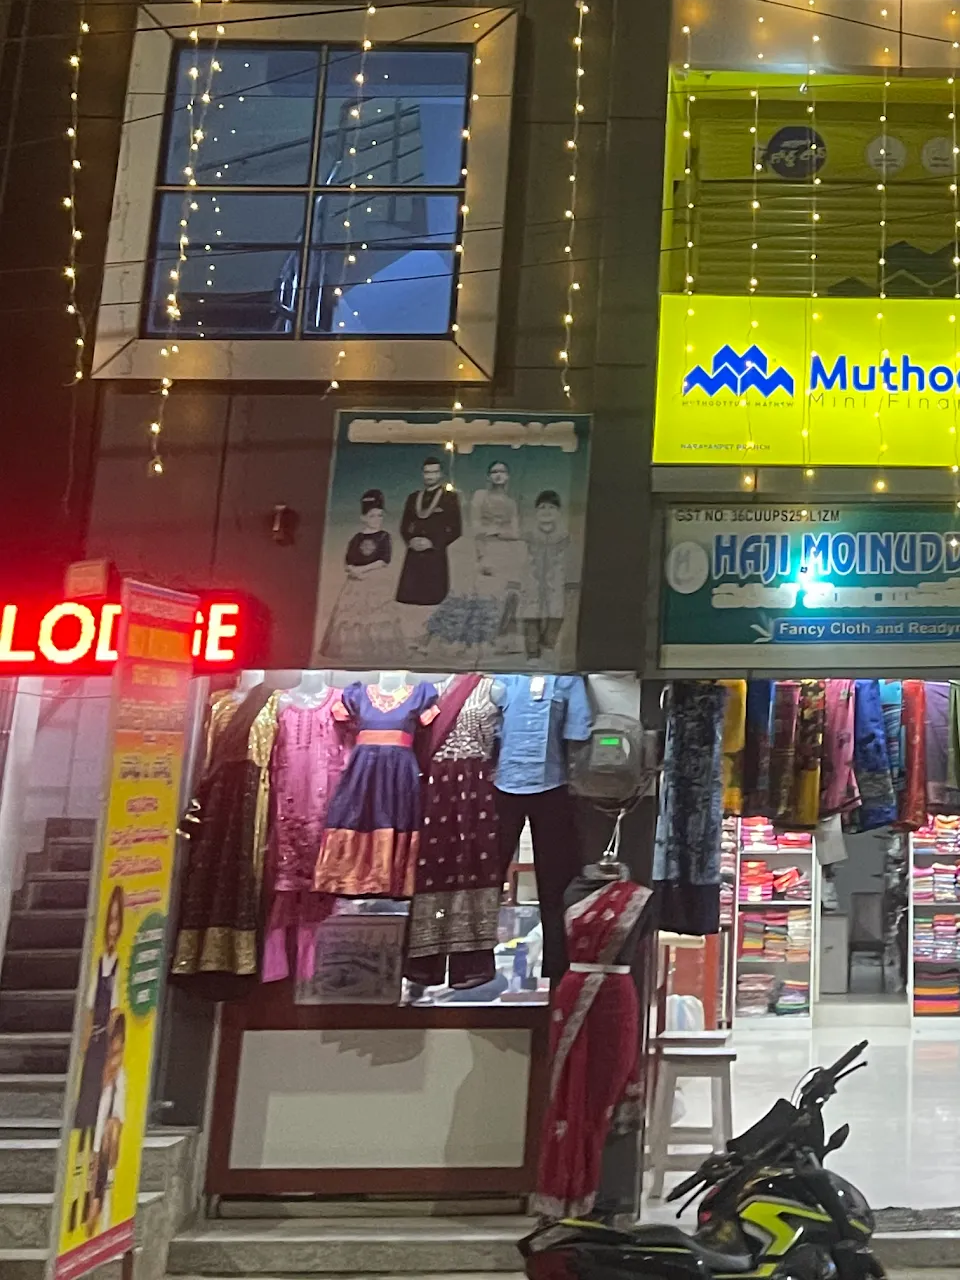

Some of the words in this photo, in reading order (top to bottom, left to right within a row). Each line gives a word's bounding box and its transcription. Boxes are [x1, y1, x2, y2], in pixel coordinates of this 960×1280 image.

[809, 392, 867, 408] Mini
[713, 533, 791, 584] HAJI
[0, 602, 239, 664] LODE
[779, 622, 826, 638] Fancy
[830, 621, 871, 635] Cloth
[875, 622, 904, 634] and
